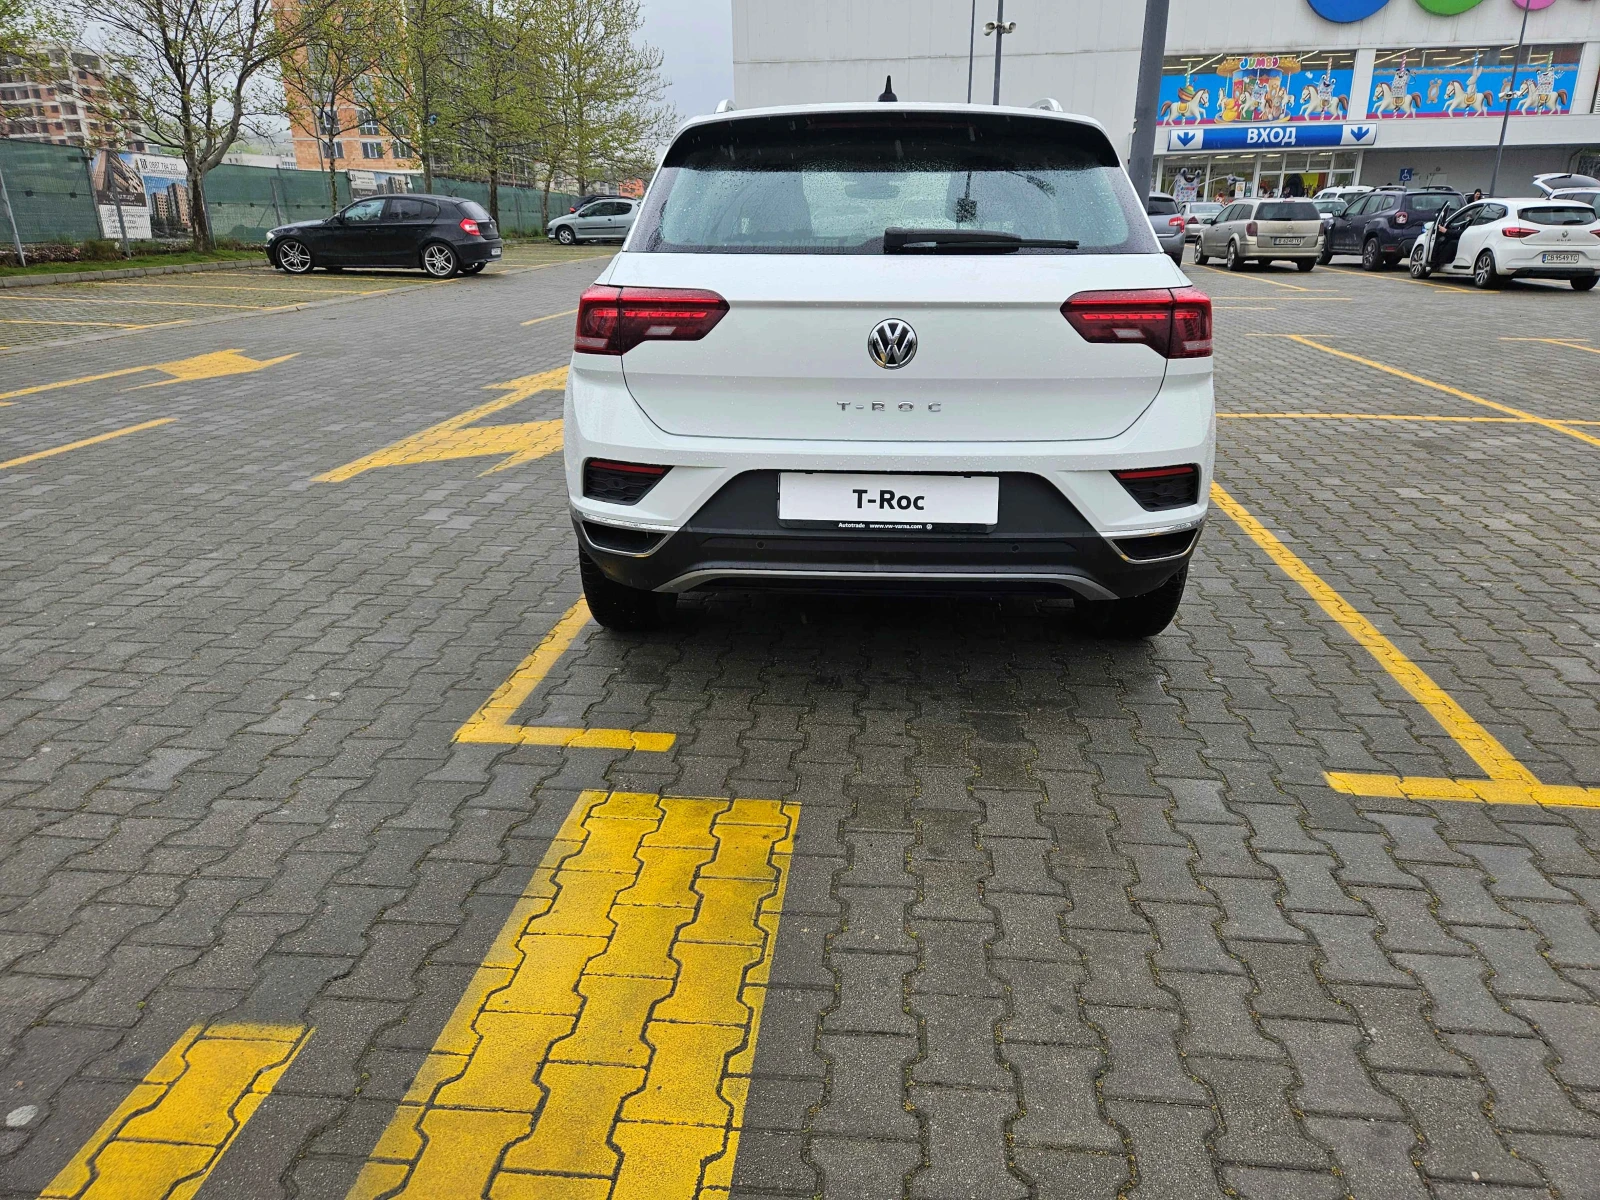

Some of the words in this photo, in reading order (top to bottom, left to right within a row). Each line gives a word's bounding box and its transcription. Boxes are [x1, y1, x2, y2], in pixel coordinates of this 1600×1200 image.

[1239, 57, 1279, 70] JUMBO
[1246, 127, 1297, 146] ВХОД
[836, 401, 942, 413] T-ROC
[852, 489, 925, 511] T-Roc
